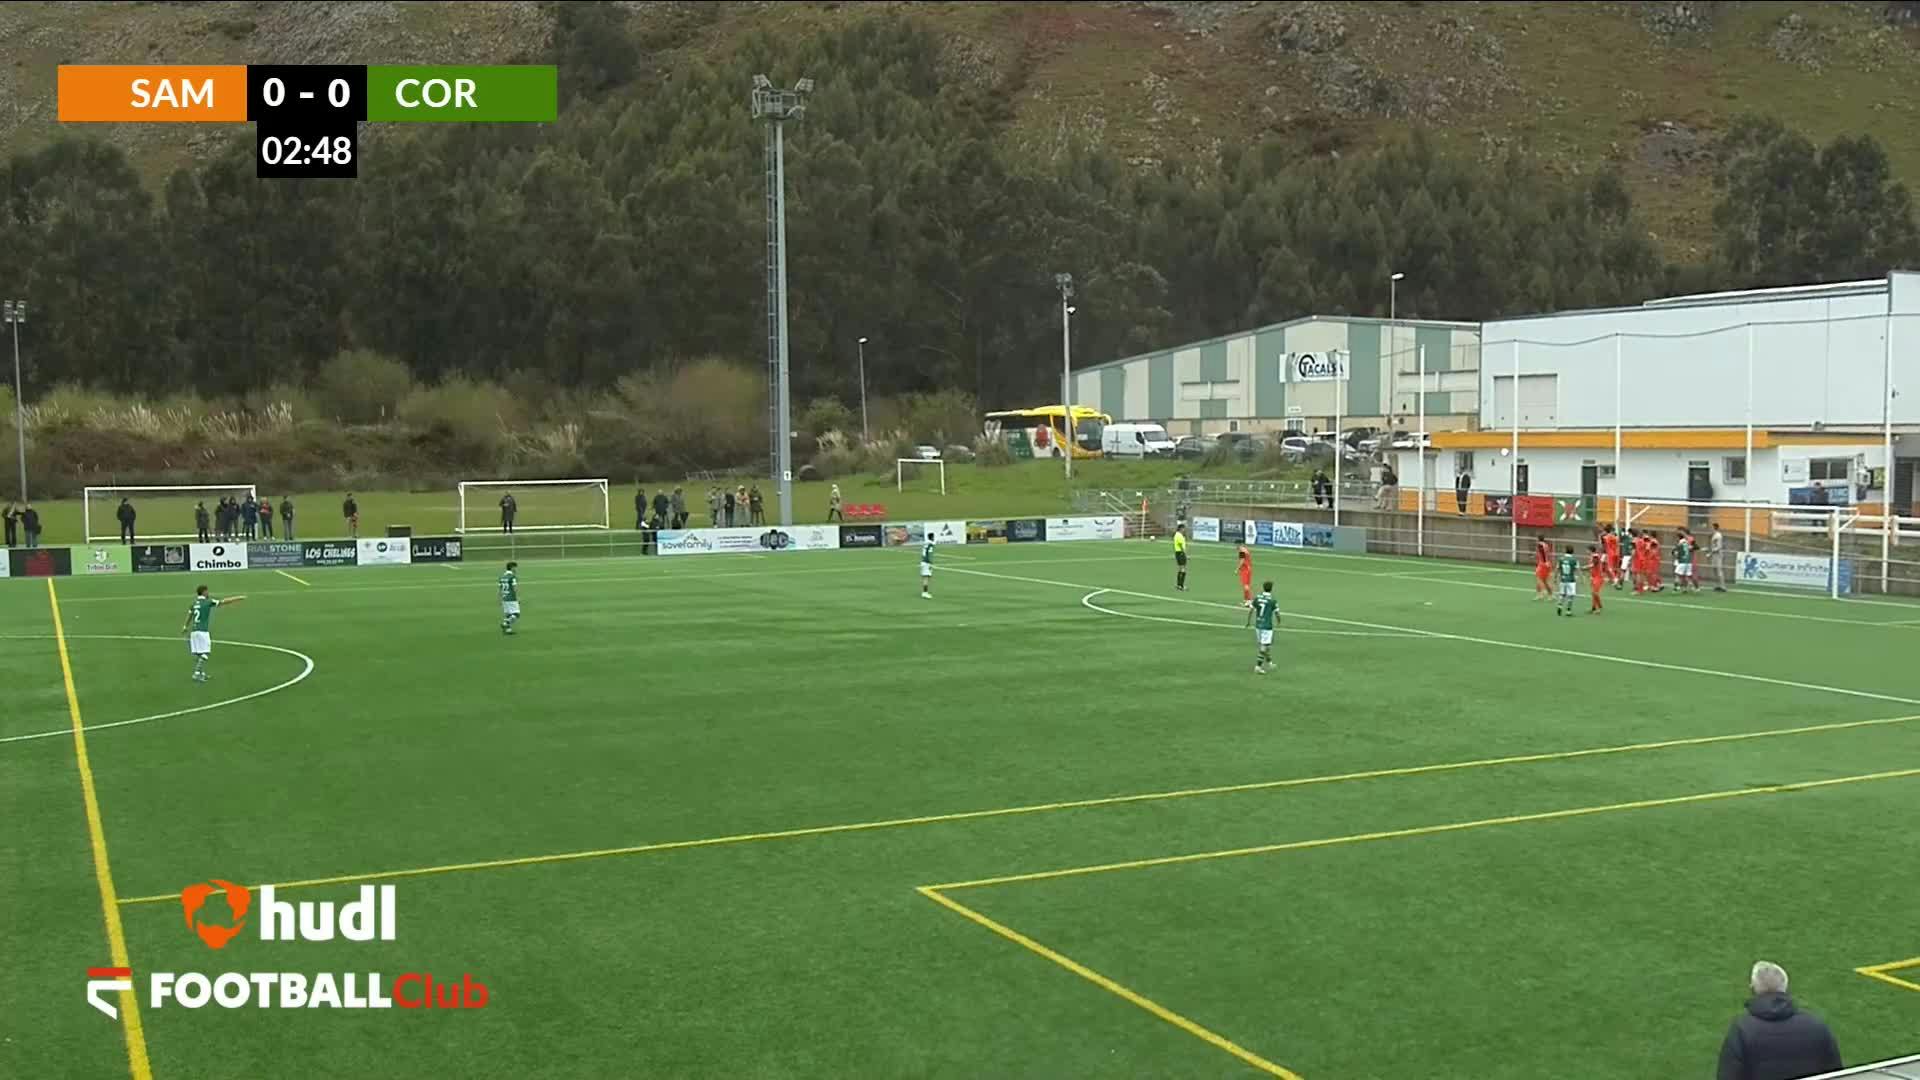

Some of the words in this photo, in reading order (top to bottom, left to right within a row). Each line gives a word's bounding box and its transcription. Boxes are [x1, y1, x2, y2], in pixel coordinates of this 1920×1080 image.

[196, 559, 242, 569] Chimbo
[193, 609, 201, 622] 2
[1259, 603, 1266, 616] 7
